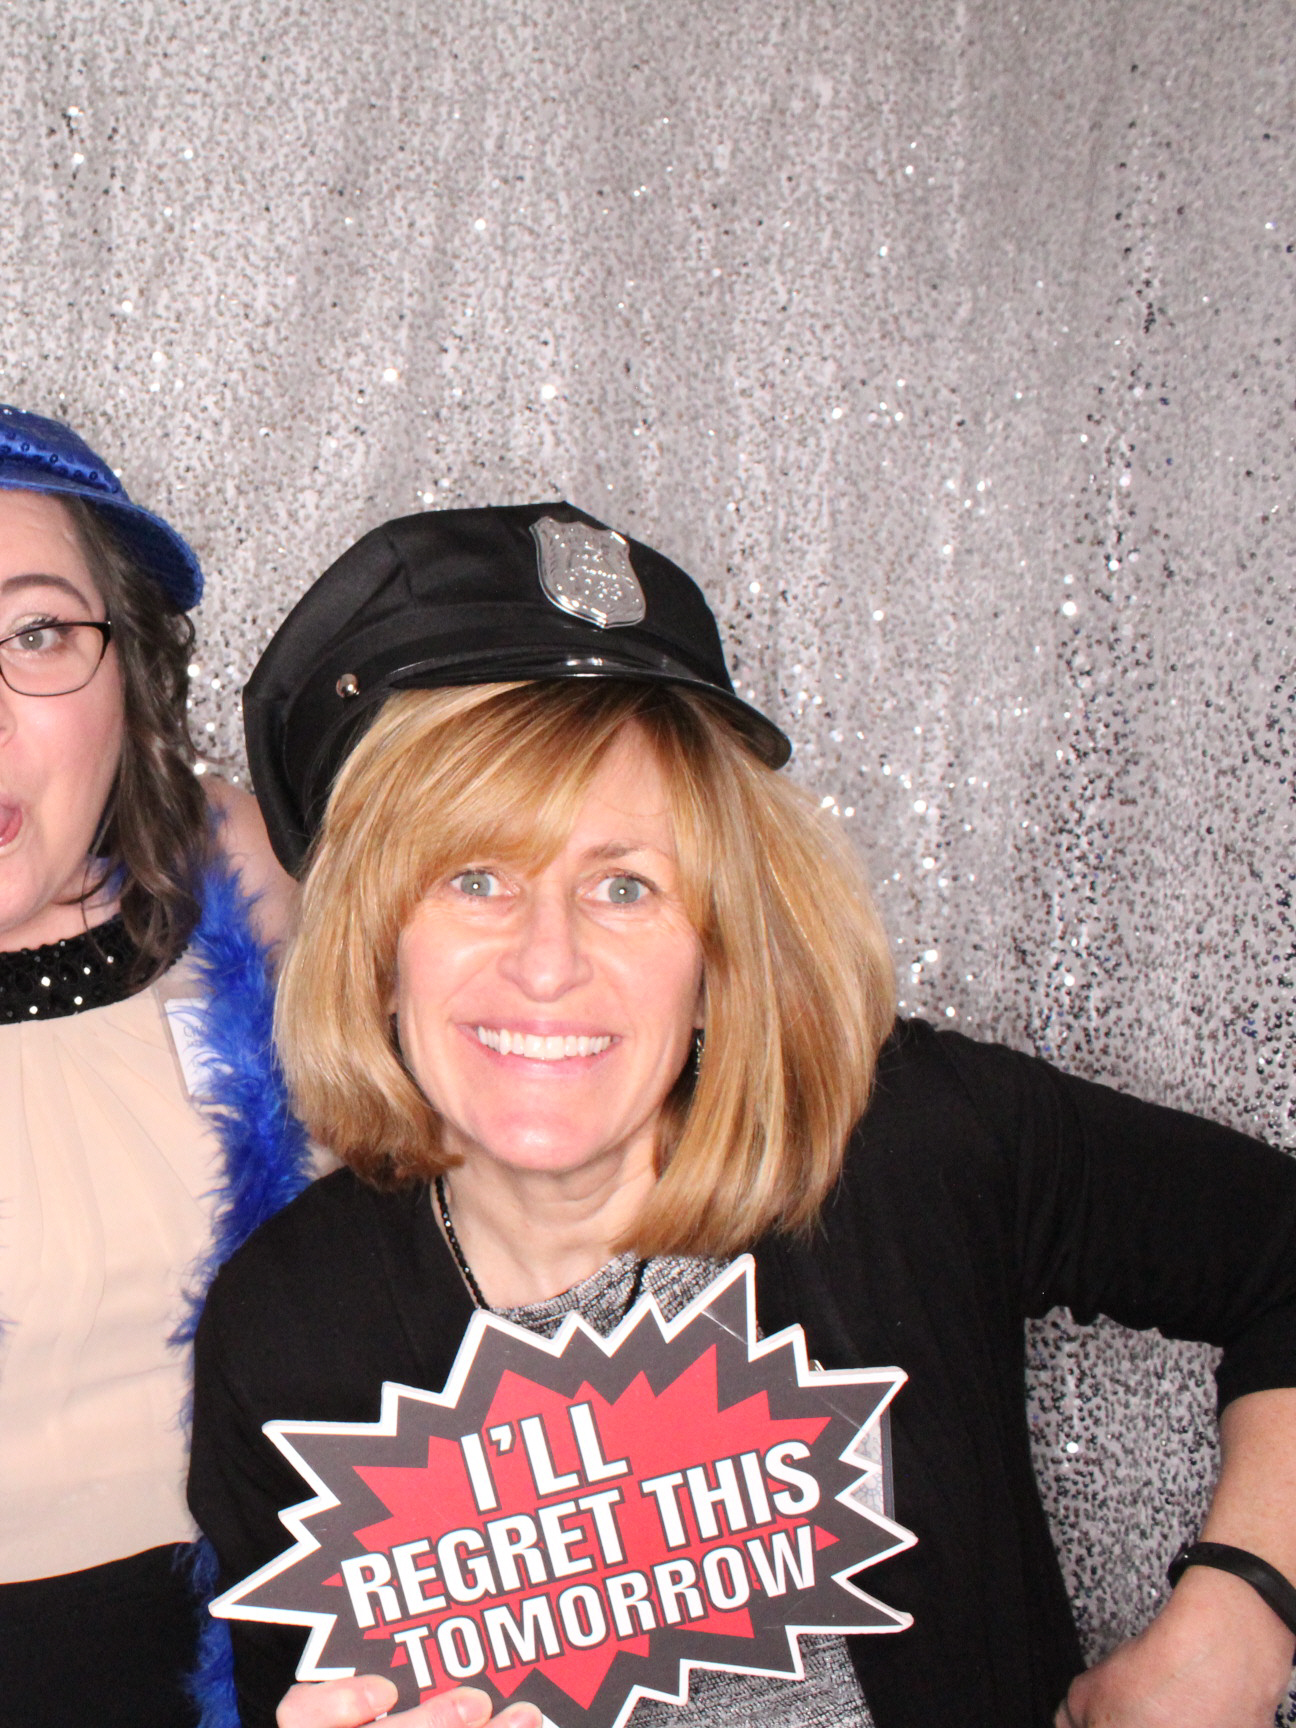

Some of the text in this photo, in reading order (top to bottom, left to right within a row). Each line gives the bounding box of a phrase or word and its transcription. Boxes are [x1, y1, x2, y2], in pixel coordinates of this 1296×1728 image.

[340, 1441, 821, 1629] REGRET THIS
[460, 1403, 629, 1512] I'LL
[393, 1525, 816, 1689] TOMORROW
